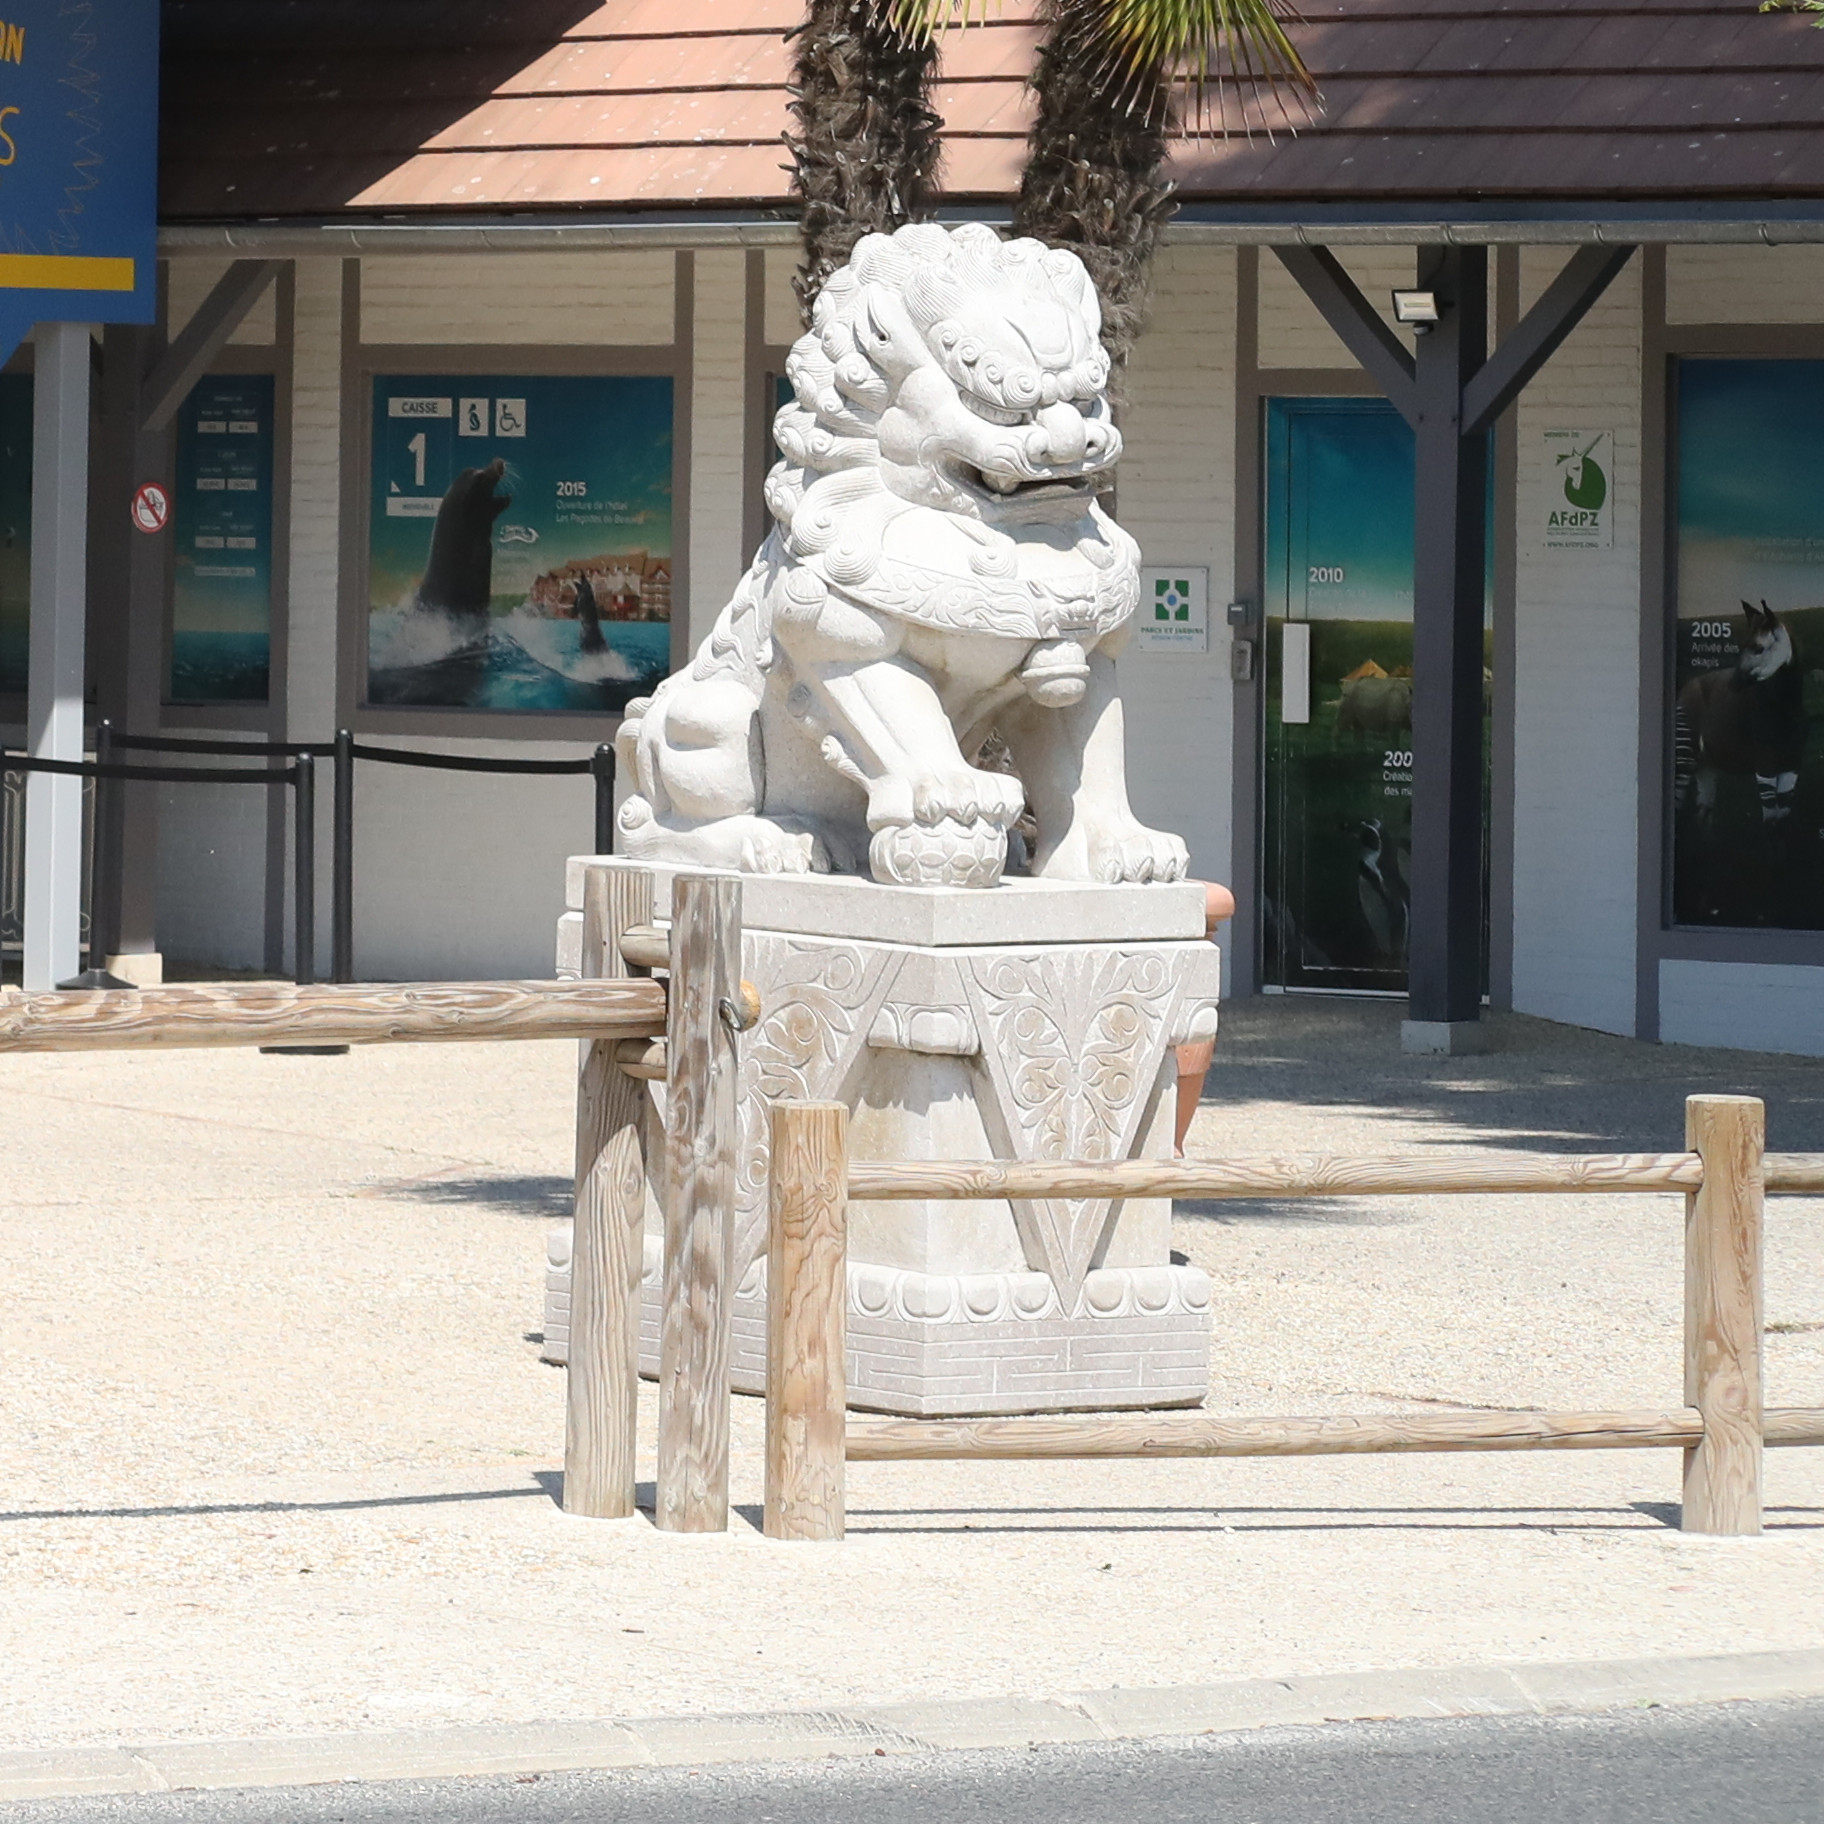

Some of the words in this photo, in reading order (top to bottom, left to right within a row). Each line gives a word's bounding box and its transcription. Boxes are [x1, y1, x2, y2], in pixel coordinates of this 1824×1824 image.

[401, 401, 439, 414] CAISSE
[408, 432, 426, 487] 1
[556, 481, 587, 496] 2015
[1548, 511, 1599, 527] AFdPZ
[1309, 567, 1343, 583] 2010
[1691, 621, 1732, 638] 2005
[1383, 751, 1413, 768] 200
